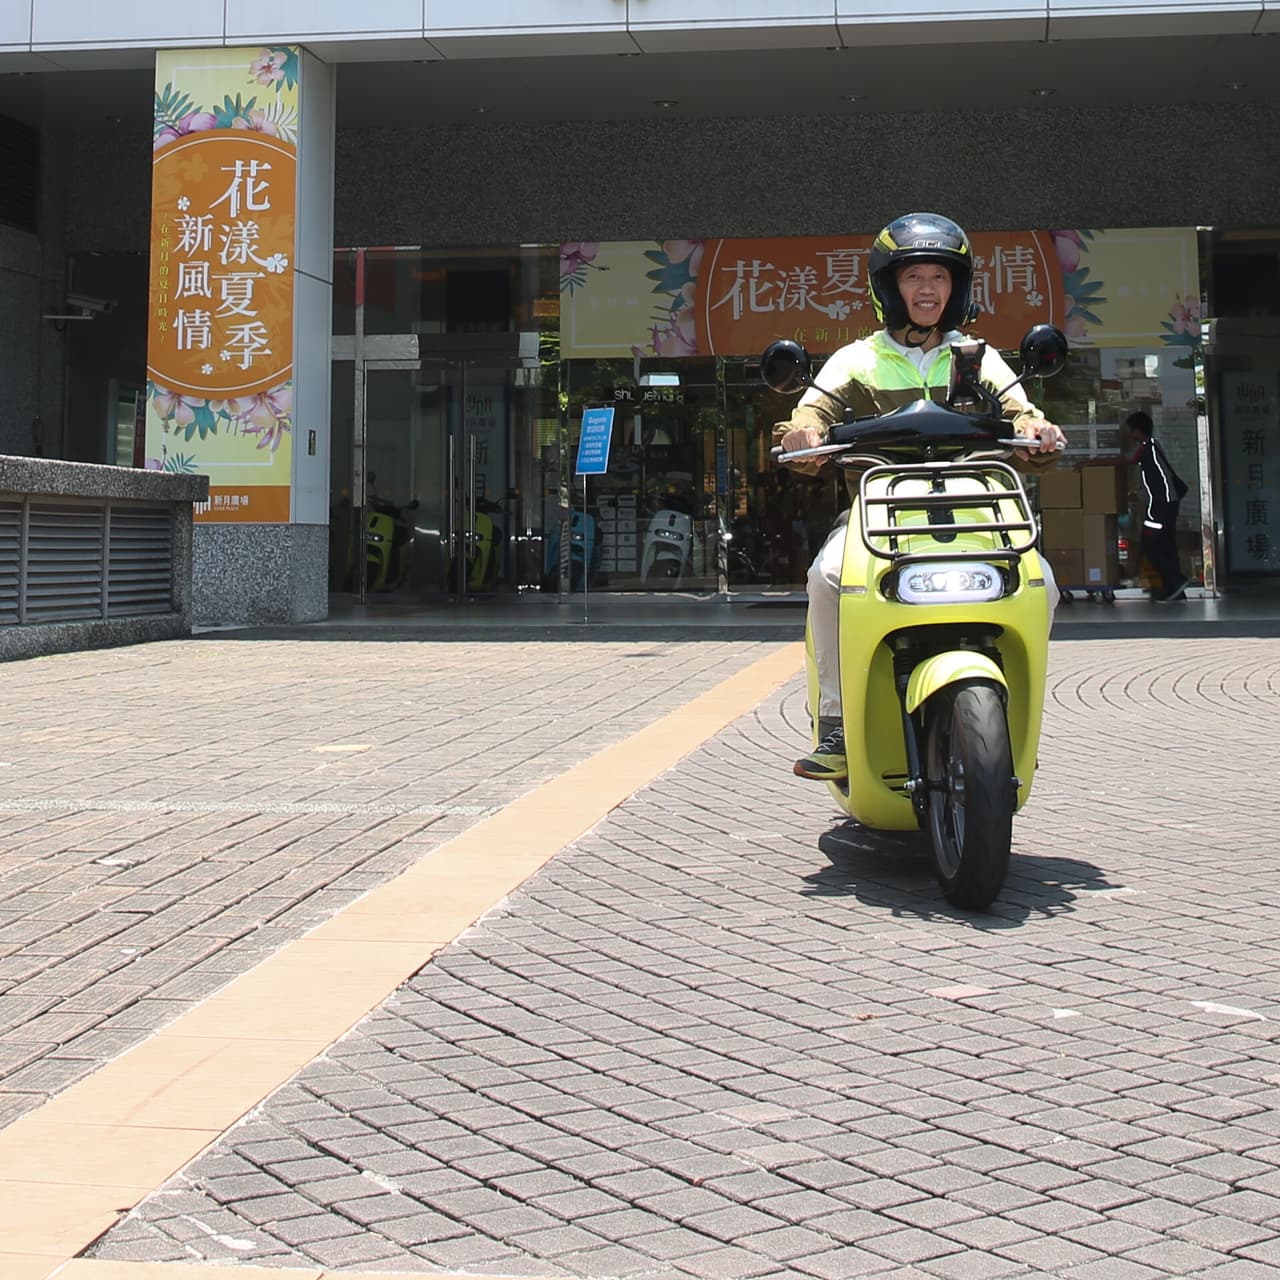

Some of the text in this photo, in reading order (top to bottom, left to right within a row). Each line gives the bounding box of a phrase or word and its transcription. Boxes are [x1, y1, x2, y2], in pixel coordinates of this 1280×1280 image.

[173, 213, 214, 352] 新風情
[209, 159, 274, 372] 花漾夏季
